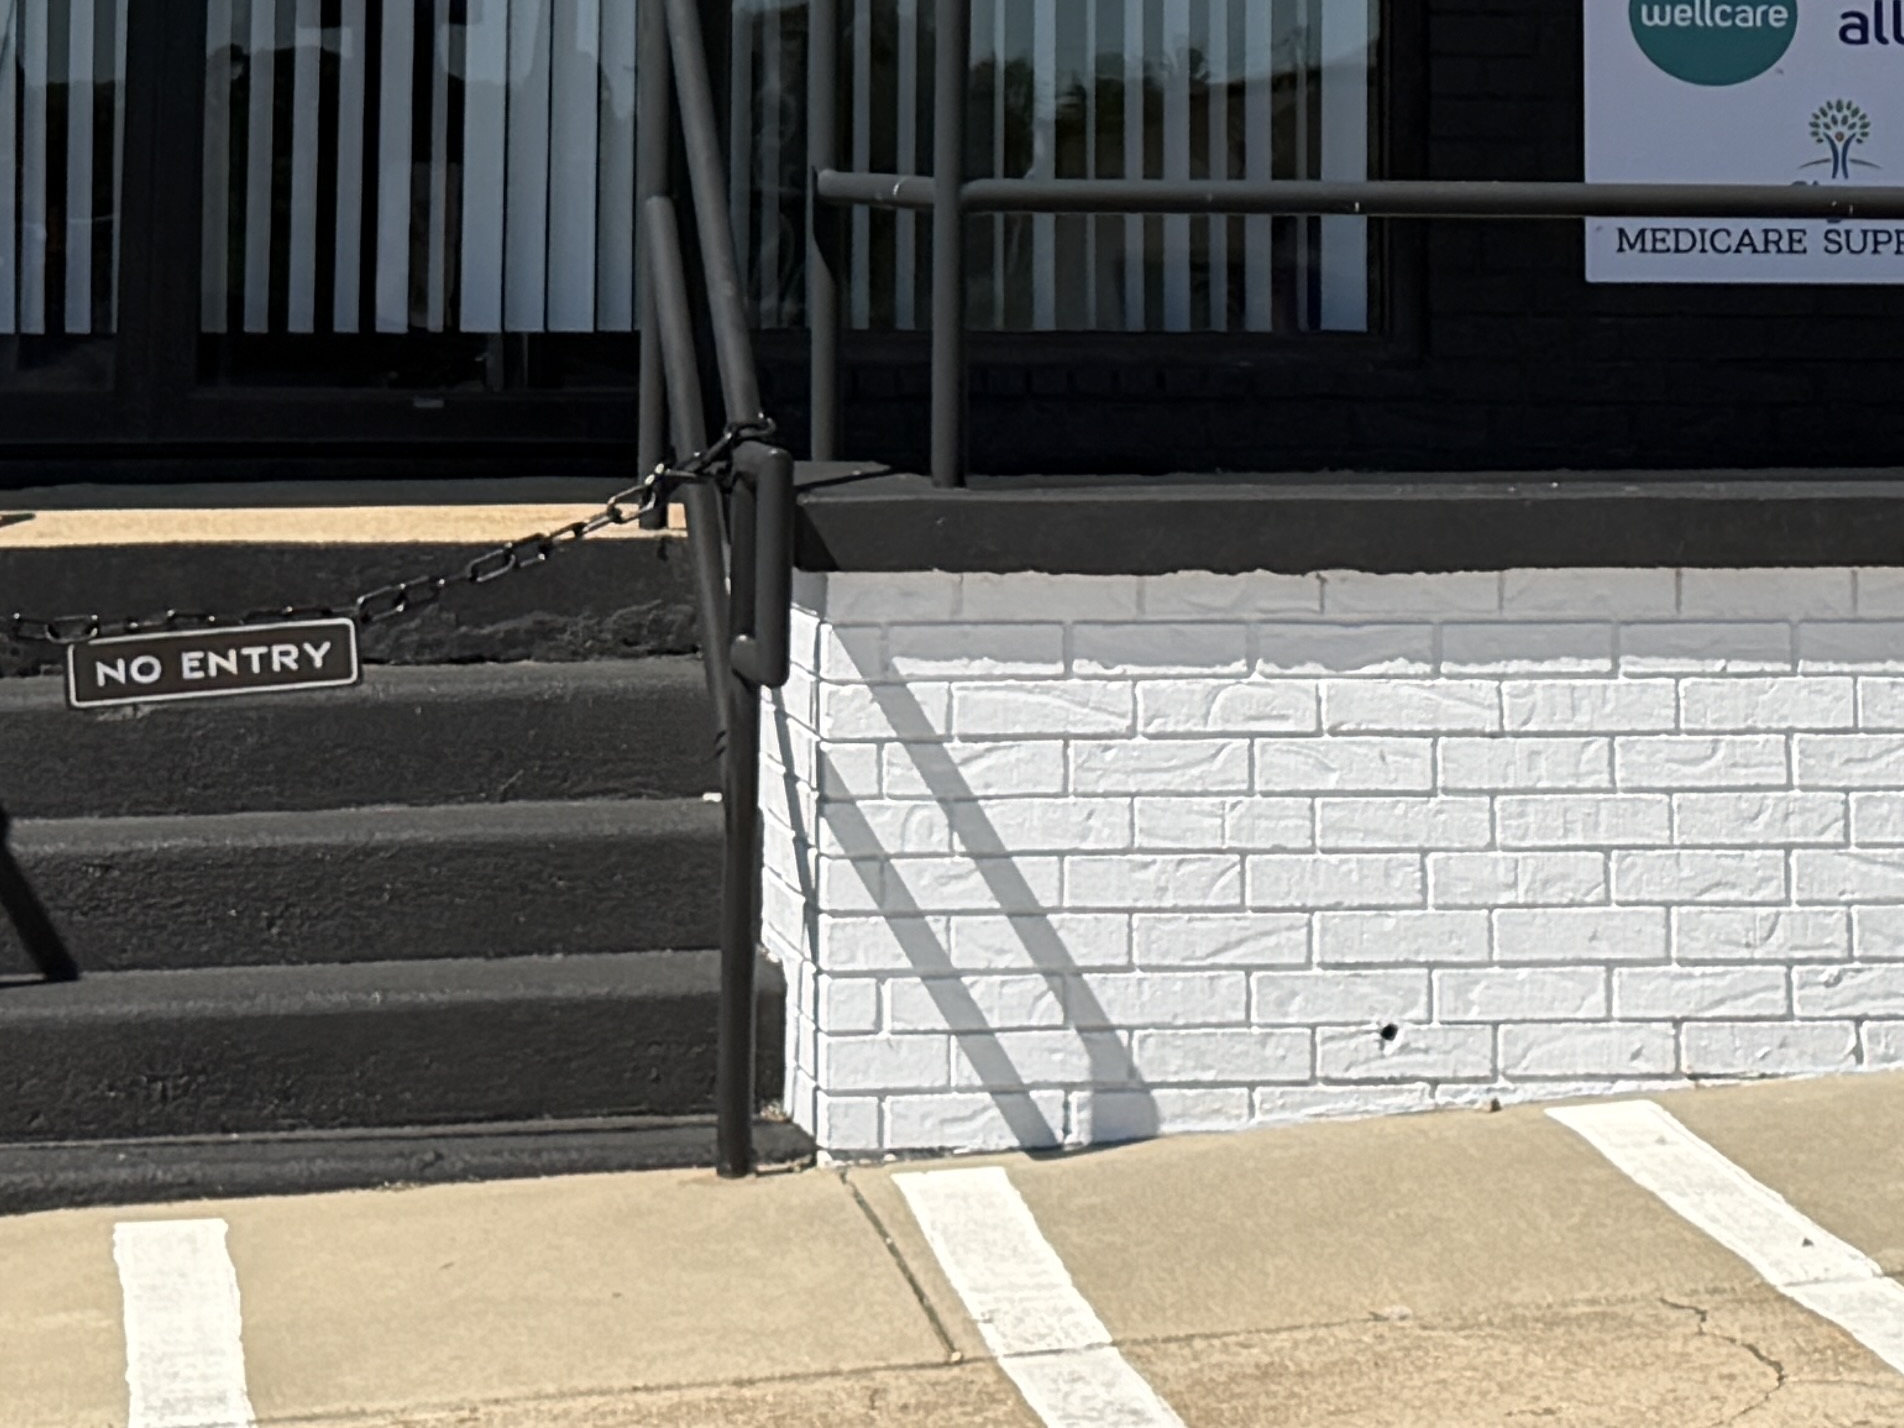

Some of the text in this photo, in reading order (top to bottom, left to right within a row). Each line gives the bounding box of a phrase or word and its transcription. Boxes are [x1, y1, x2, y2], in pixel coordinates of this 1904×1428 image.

[1615, 227, 1808, 255] MEDICARE
[95, 640, 332, 688] NO ENTRY
